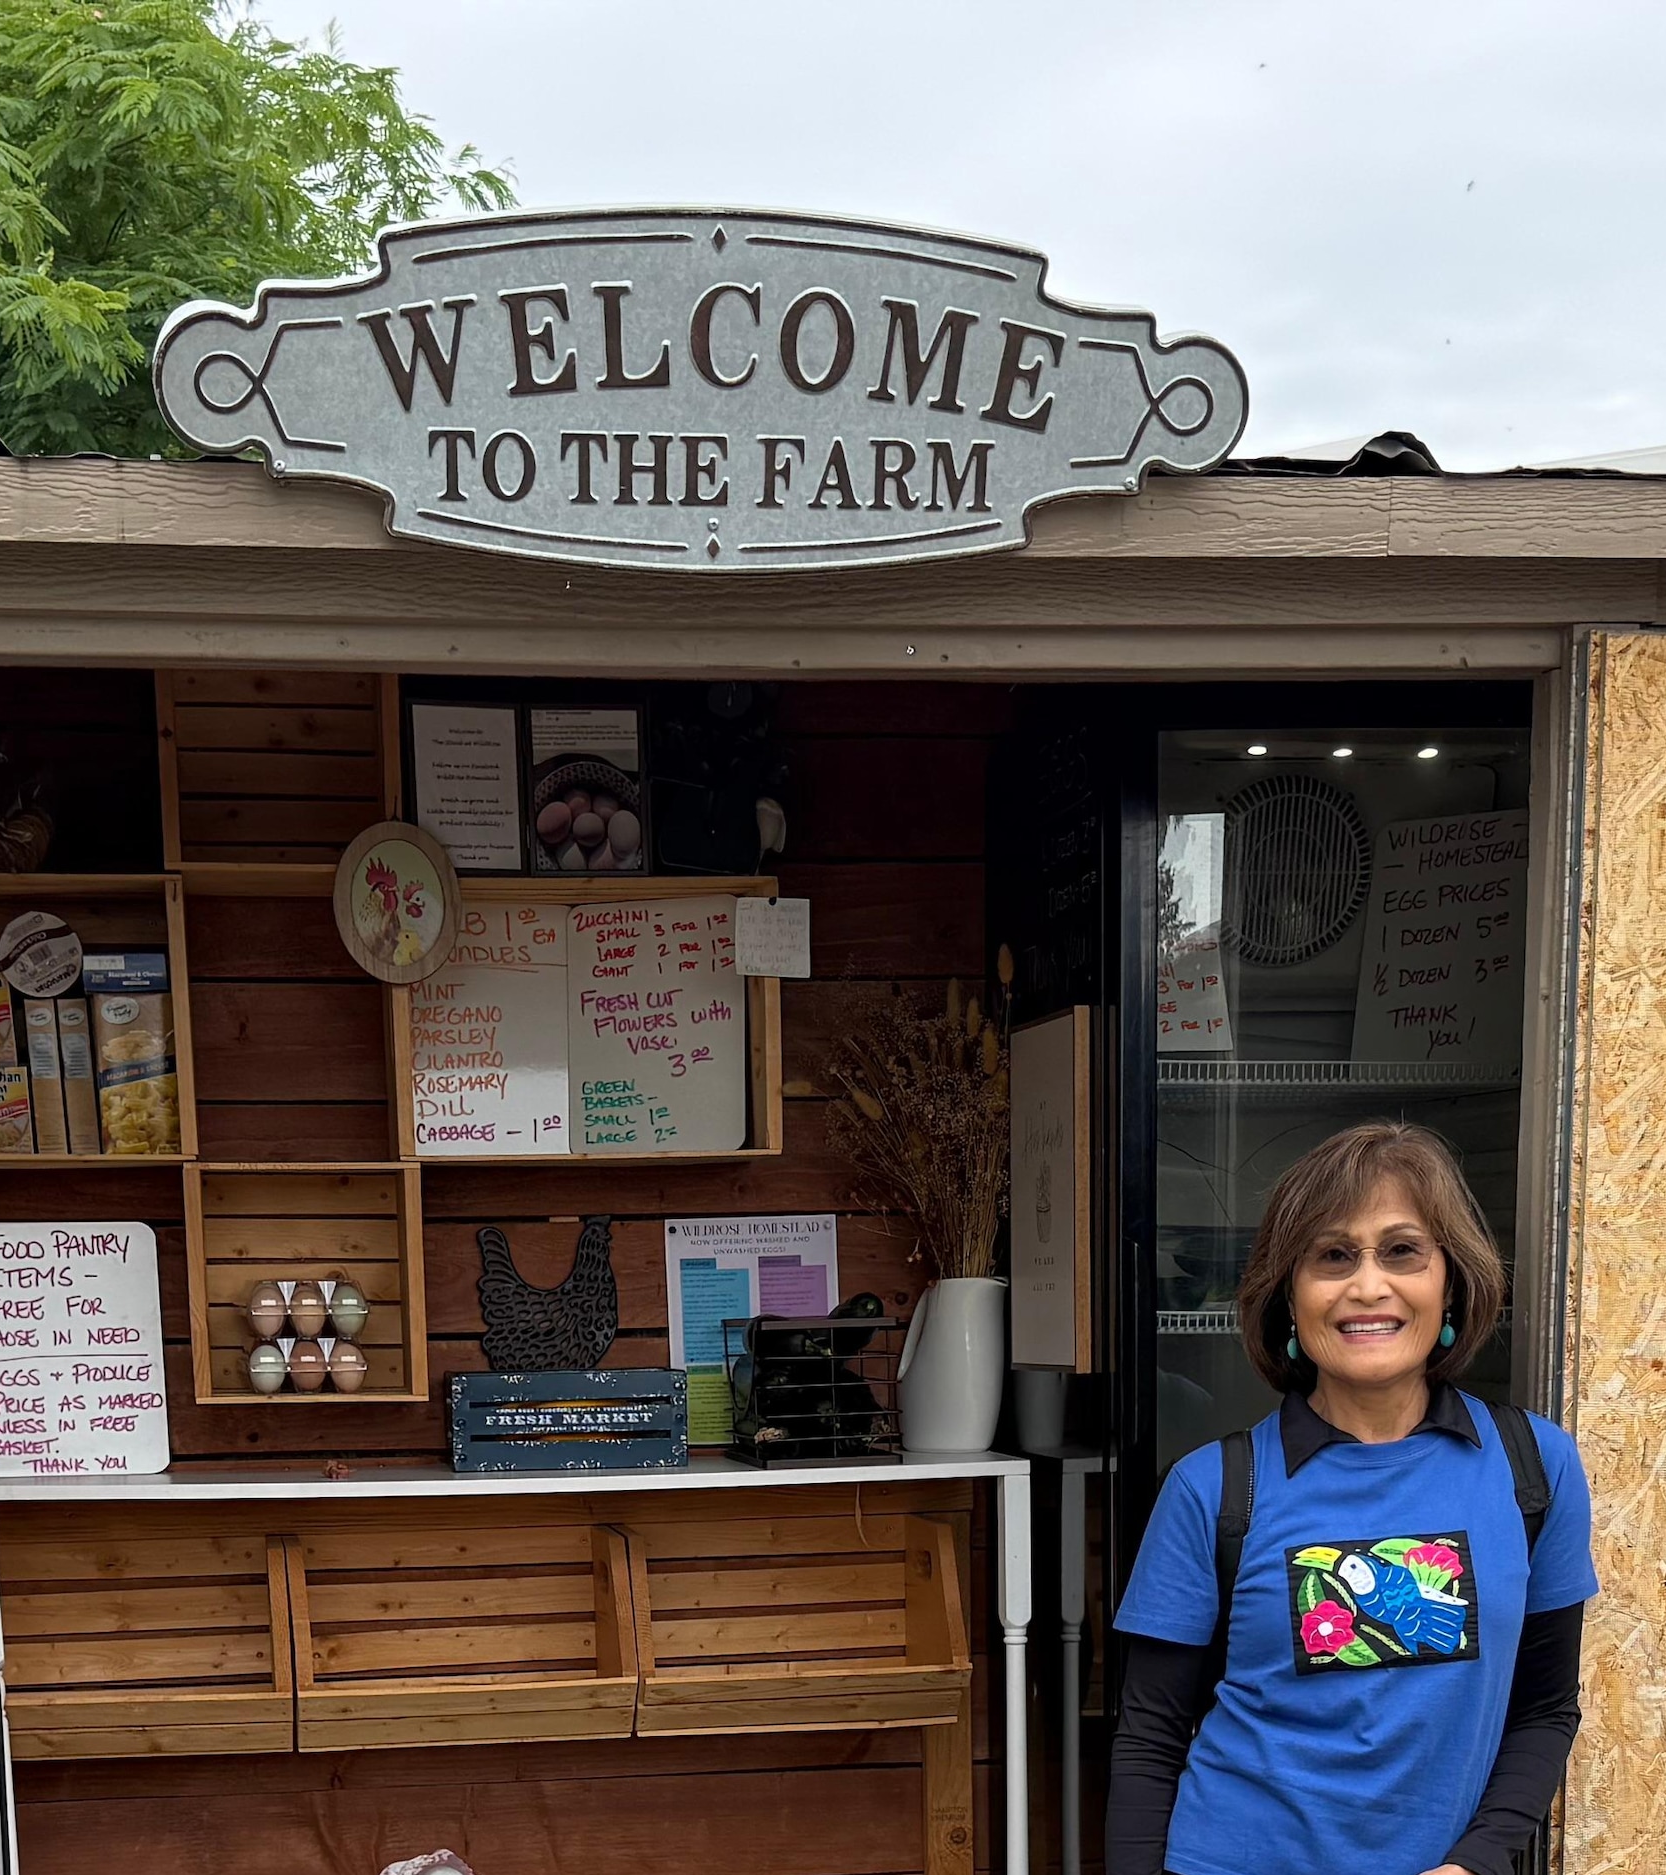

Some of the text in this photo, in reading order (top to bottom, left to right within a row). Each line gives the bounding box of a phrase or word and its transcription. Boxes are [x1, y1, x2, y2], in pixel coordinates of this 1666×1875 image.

[357, 281, 1066, 430] WELCOME
[428, 428, 994, 512] TO THE FARM
[1383, 878, 1510, 913] EGG PRICES
[533, 929, 556, 944] EA
[596, 928, 641, 942] SMALL
[653, 924, 665, 936] 3
[672, 922, 698, 933] FOR
[1401, 922, 1461, 946] DOZEN
[448, 945, 532, 962] UNDLES
[598, 945, 637, 962] LARGE
[658, 944, 671, 957] 2
[679, 942, 702, 952] FOR
[592, 964, 634, 977] GIANT
[658, 963, 662, 974] 1
[1398, 964, 1450, 987] DOZEN
[409, 982, 466, 1000] MINT
[580, 988, 683, 1016] FRESH CUT
[412, 1005, 502, 1025] OREGANO
[594, 1000, 731, 1038] FLOWERS with
[1387, 1004, 1457, 1028] THANK
[412, 1027, 496, 1051] PARSLEY
[412, 1051, 504, 1070] CILANTRO
[414, 1072, 508, 1100] ROSEMARY
[581, 1079, 636, 1095] GREEN
[417, 1095, 474, 1119] DILL
[584, 1113, 637, 1127] SMALL
[416, 1122, 496, 1144] CABBAGE
[585, 1130, 638, 1144] LARGE
[682, 1221, 820, 1237] WILDROSE HOMESTEAD
[51, 1229, 130, 1263] PANTRY
[713, 1238, 753, 1246] OFFERING
[713, 1247, 760, 1255] UNWASHED
[66, 1295, 106, 1316] FOR
[53, 1329, 72, 1345] IN
[87, 1327, 140, 1345] NEED
[72, 1363, 153, 1384] PRODUCE
[59, 1398, 86, 1410] AS
[98, 1392, 163, 1410] MARKED
[59, 1416, 75, 1431] IN
[90, 1414, 138, 1432] FREE
[486, 1411, 653, 1426] FRESH MARKET
[23, 1455, 127, 1474] THANK YOU
